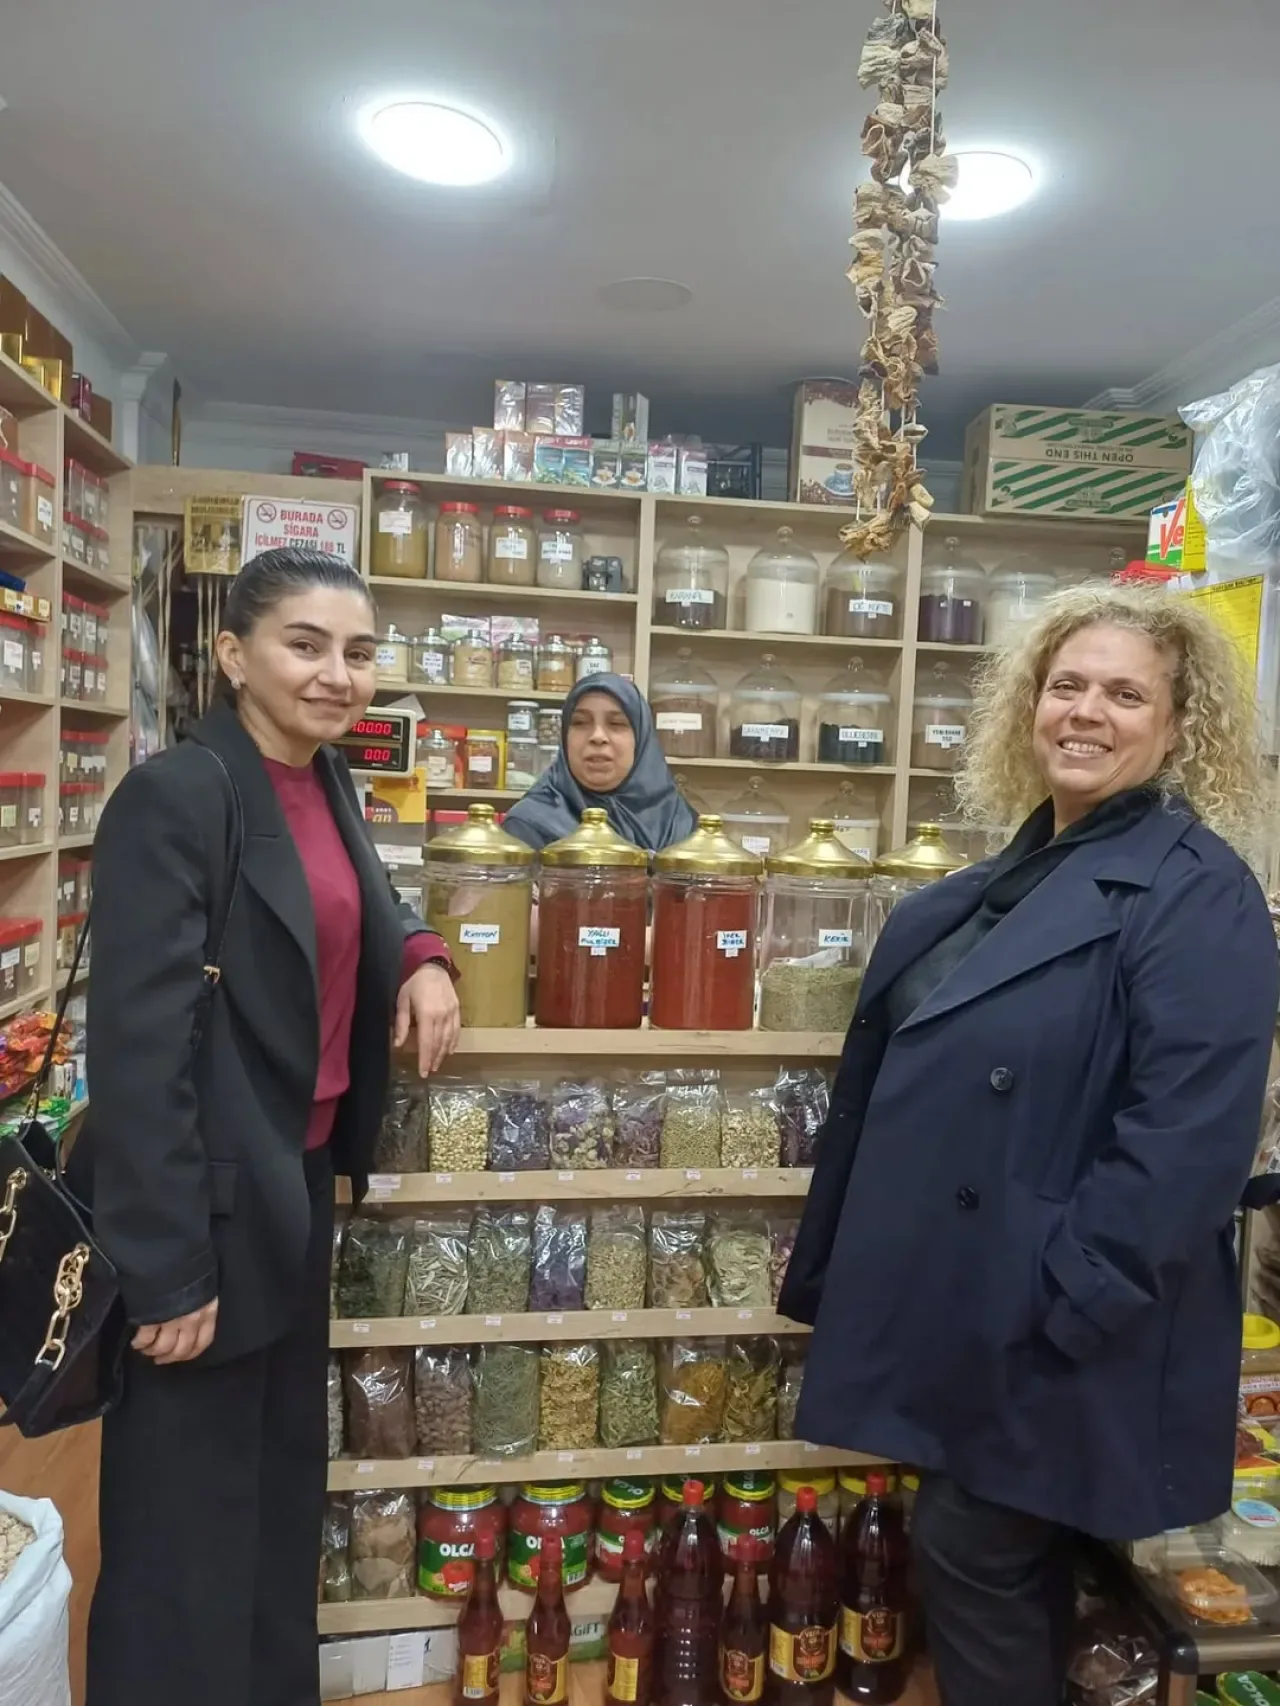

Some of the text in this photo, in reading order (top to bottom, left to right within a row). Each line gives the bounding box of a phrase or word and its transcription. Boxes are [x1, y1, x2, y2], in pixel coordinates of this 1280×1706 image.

[1045, 448, 1134, 463] OPEN THIS END
[280, 509, 324, 524] BURADA
[283, 522, 320, 537] SİGARA
[337, 542, 346, 554] TL
